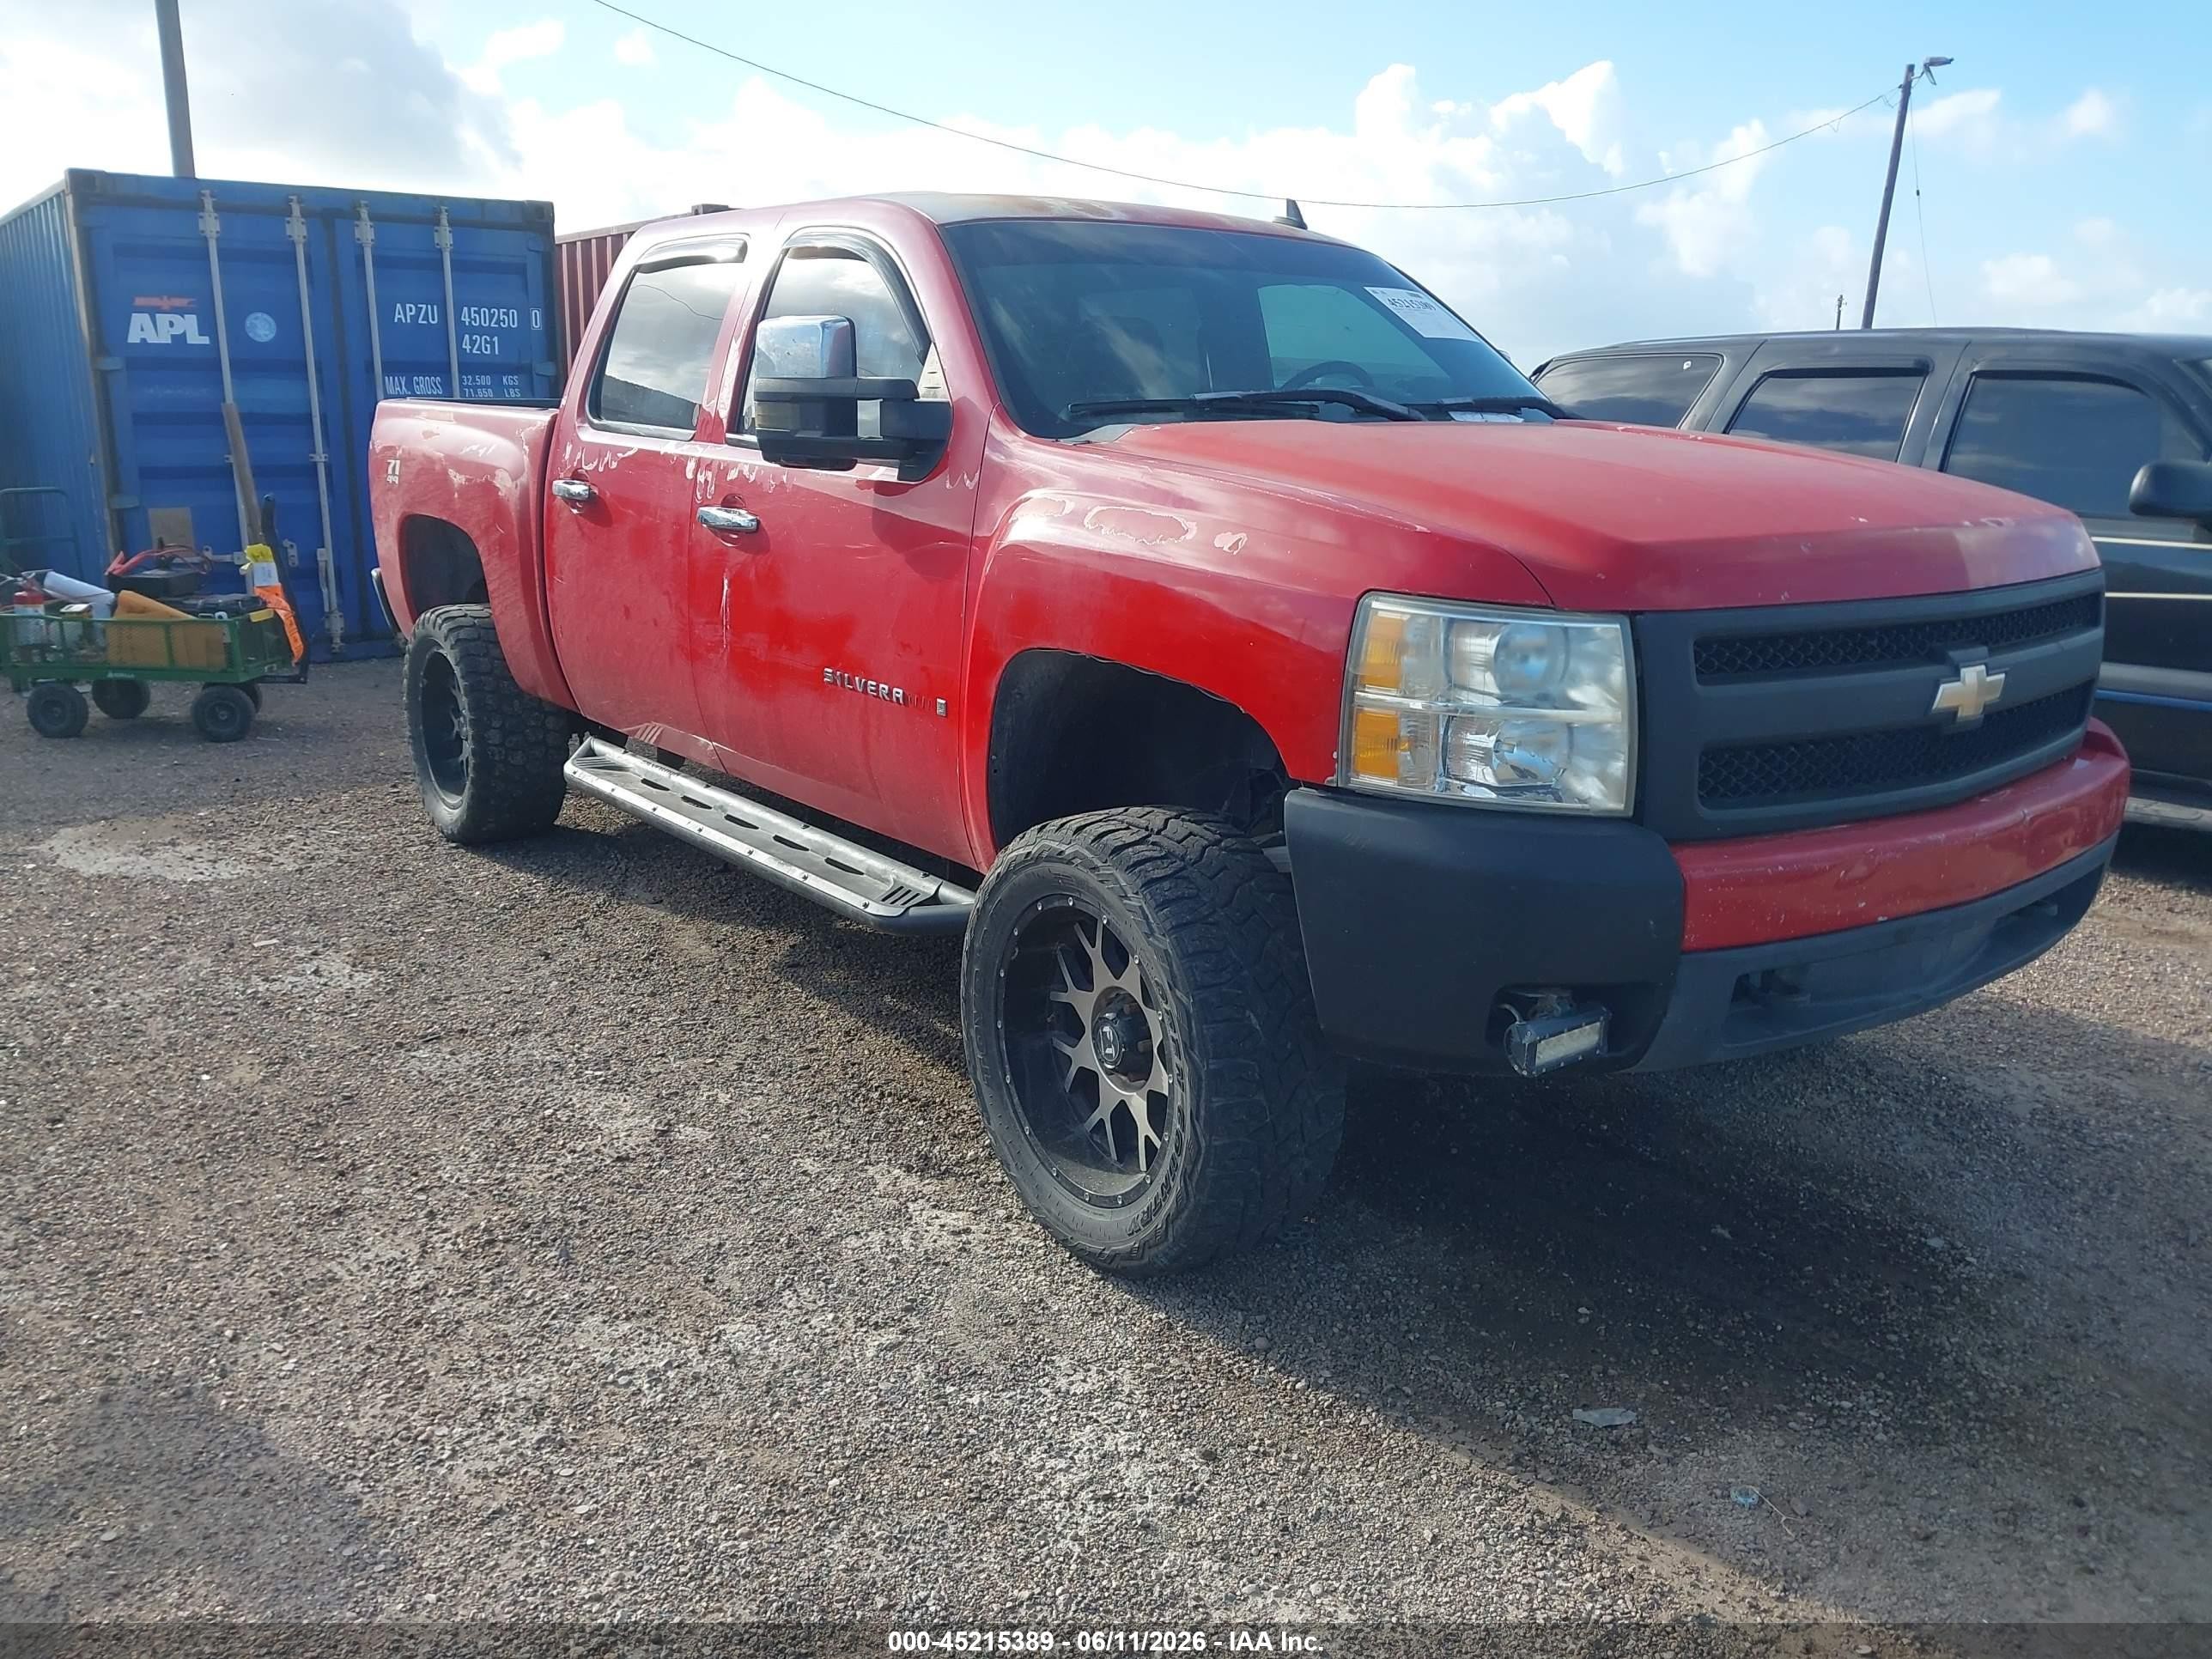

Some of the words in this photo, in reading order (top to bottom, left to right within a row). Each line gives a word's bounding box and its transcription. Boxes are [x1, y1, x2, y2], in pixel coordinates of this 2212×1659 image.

[394, 303, 438, 324] APZU
[461, 307, 518, 328] 450250
[531, 309, 541, 329] 0
[127, 313, 210, 344] APL
[462, 334, 499, 355] 42G1
[385, 376, 410, 395] MAX.
[413, 376, 442, 395] GROSS
[462, 375, 491, 386] 32.500
[503, 375, 519, 386] KGS
[505, 388, 520, 398] LBS
[1126, 1104, 1185, 1237] COUNTRY
